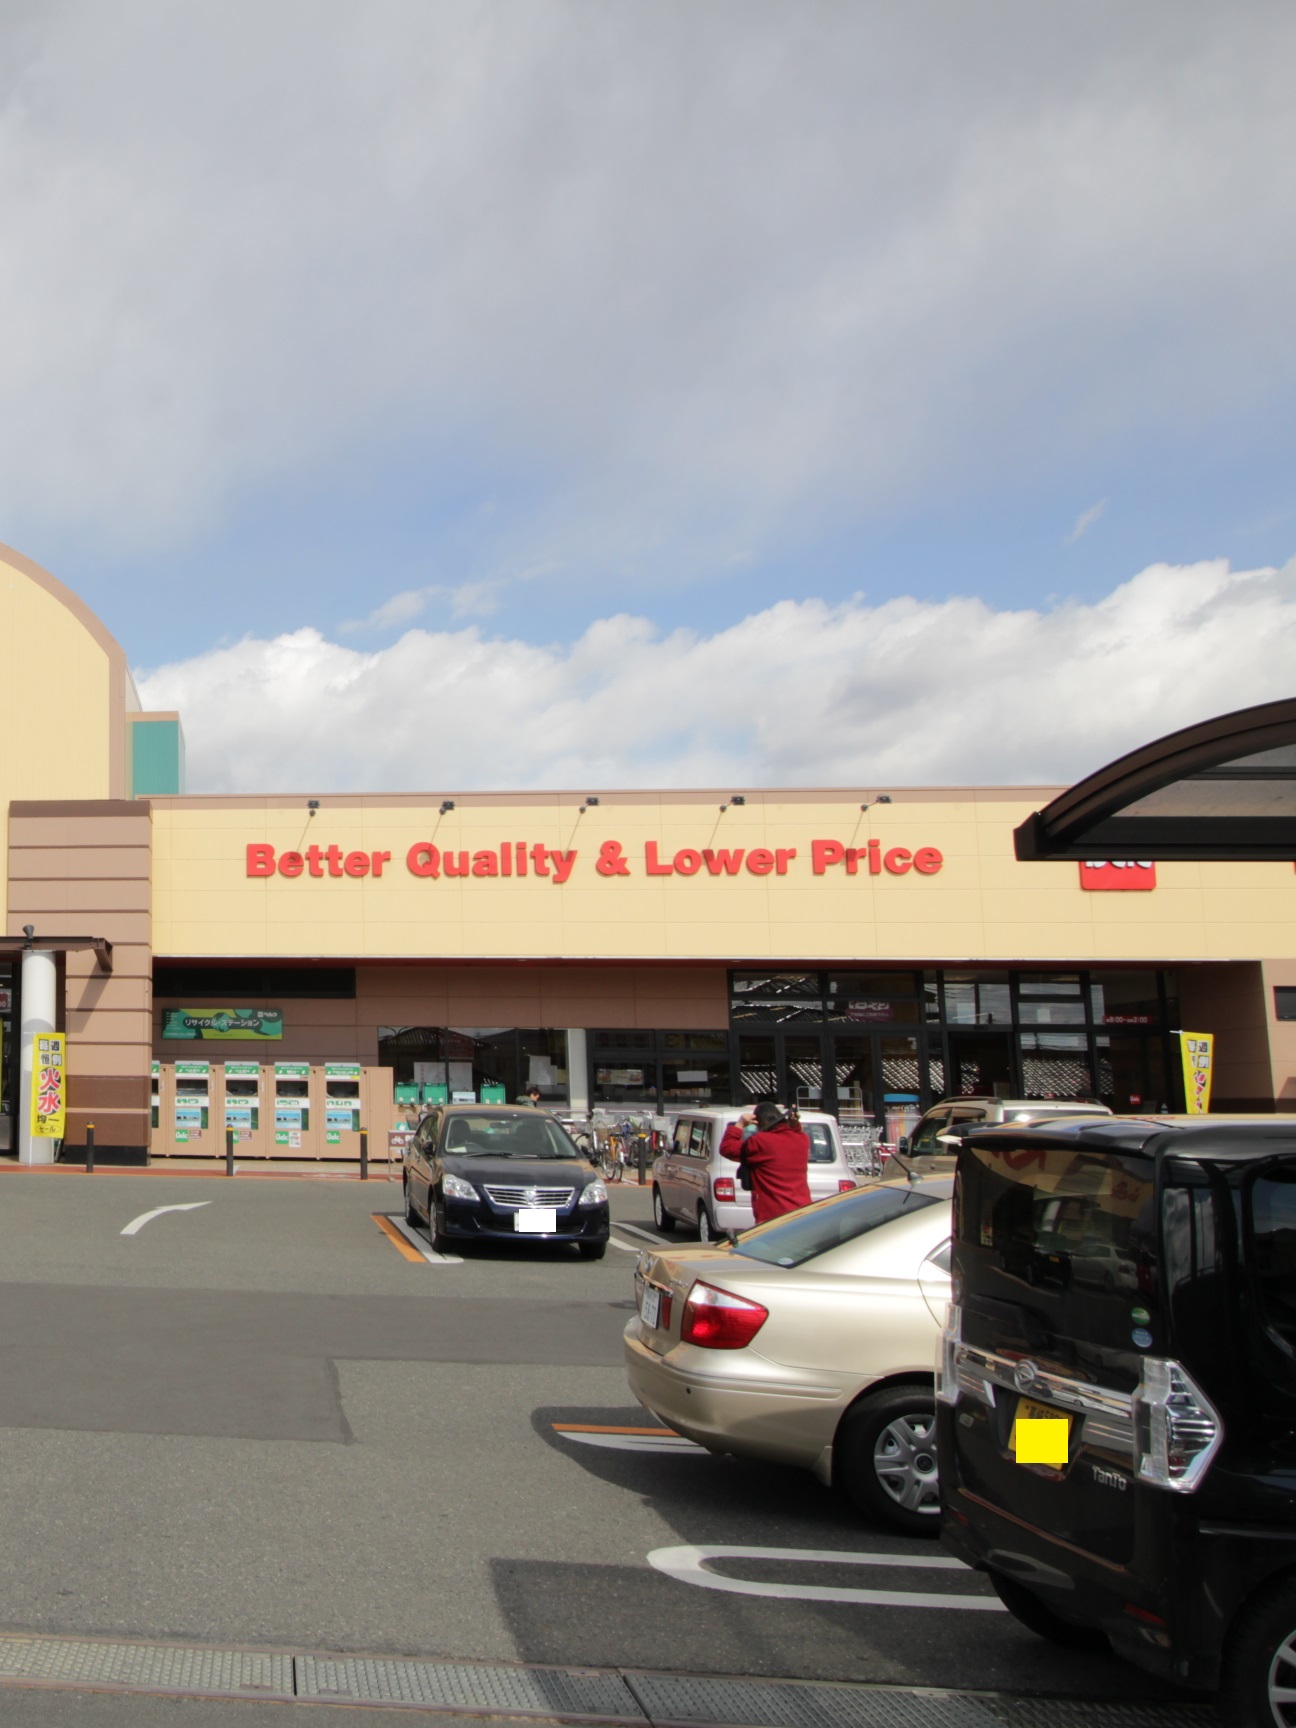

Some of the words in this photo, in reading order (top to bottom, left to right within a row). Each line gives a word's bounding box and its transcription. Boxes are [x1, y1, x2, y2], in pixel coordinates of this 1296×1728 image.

[246, 843, 391, 878] Better
[406, 841, 578, 884] Quality
[595, 839, 631, 876] &
[644, 840, 797, 877] Lower
[811, 839, 944, 876] Price
[39, 1039, 60, 1051] 毎週
[40, 1054, 62, 1066] 恒例
[37, 1114, 59, 1123] 均一
